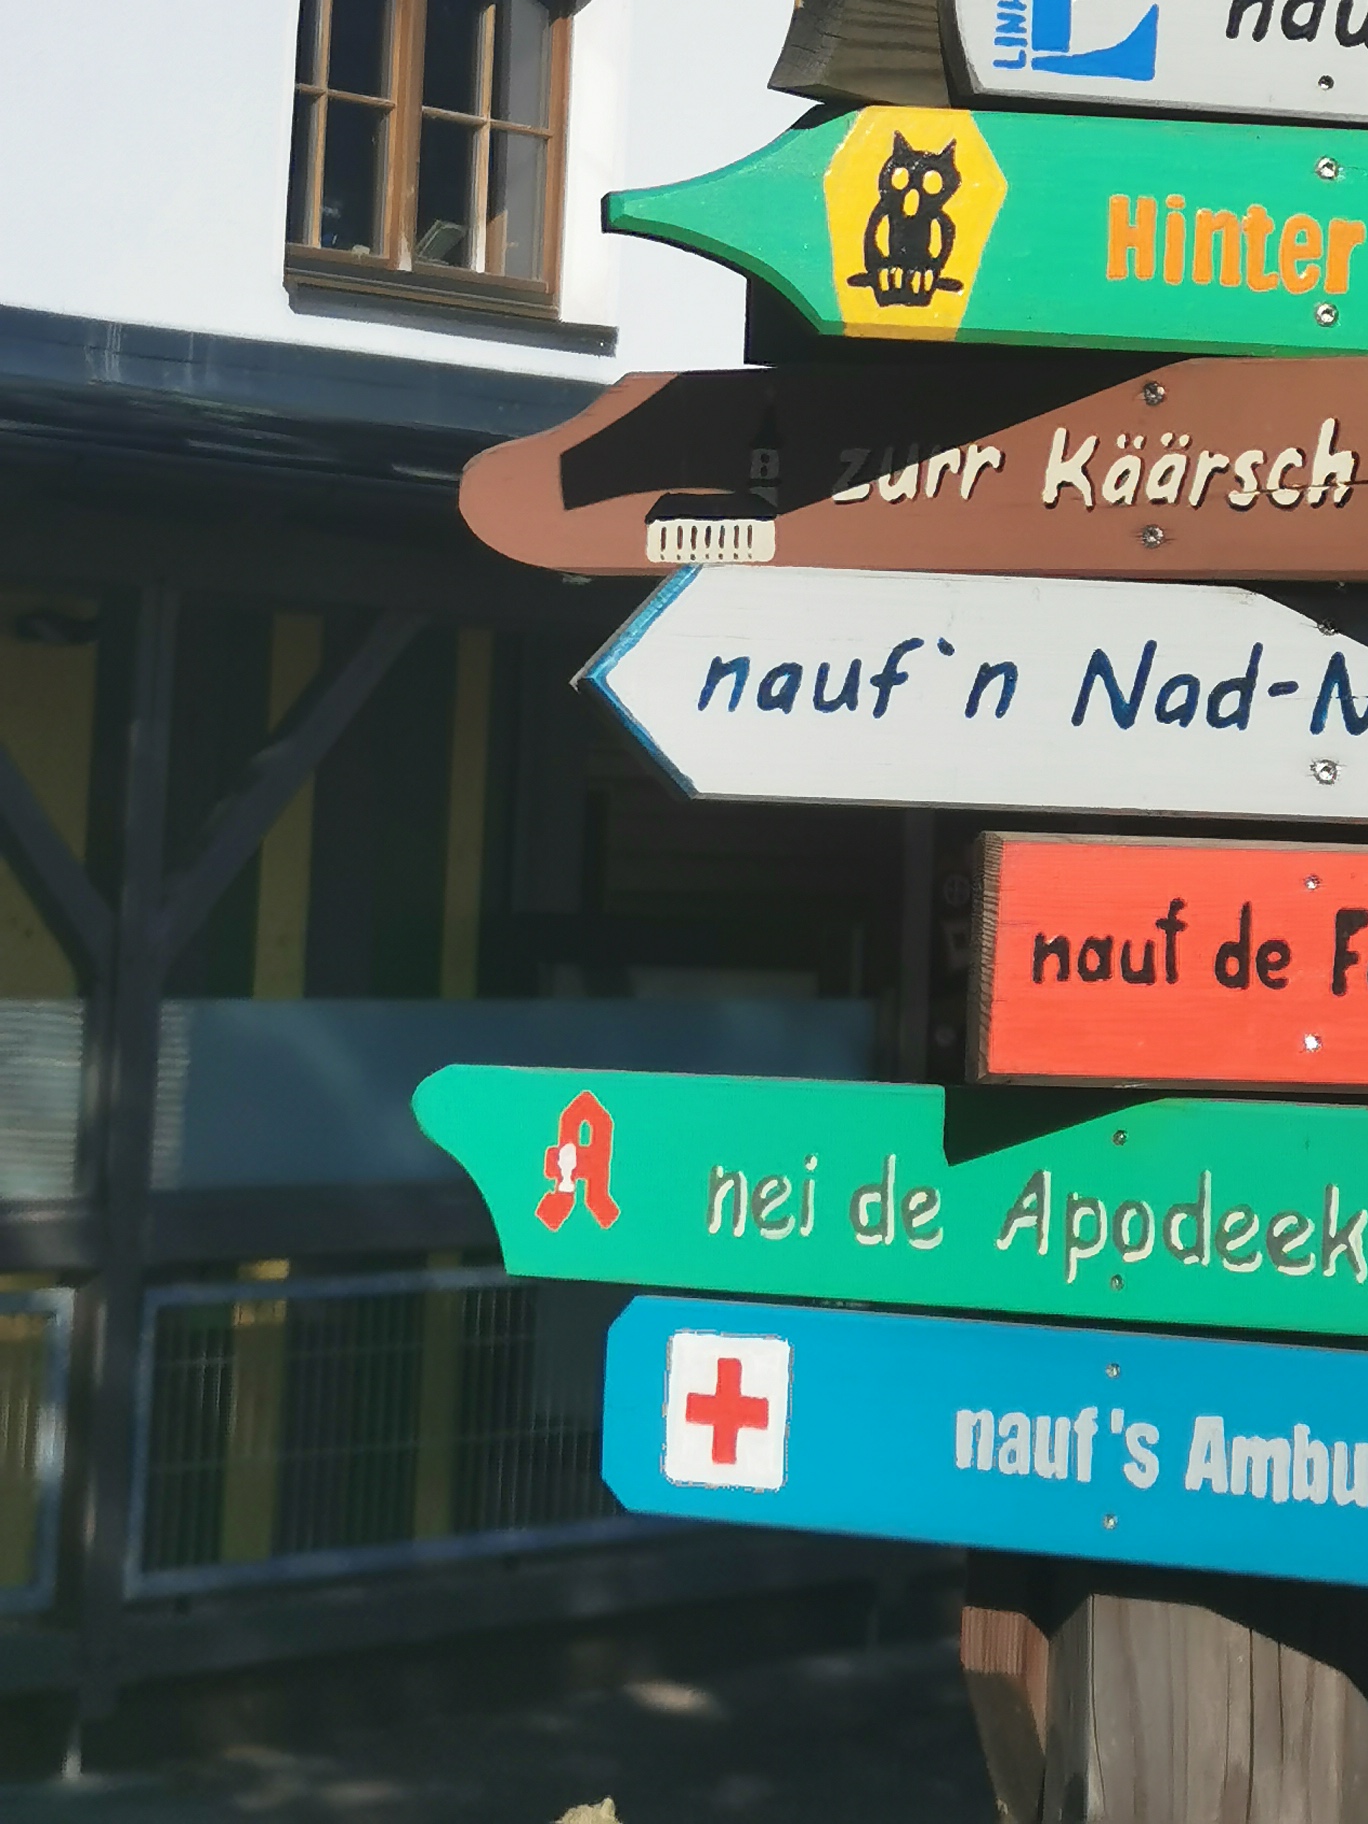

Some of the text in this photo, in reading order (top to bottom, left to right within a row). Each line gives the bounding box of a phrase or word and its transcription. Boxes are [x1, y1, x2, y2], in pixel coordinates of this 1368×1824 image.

[1107, 192, 1365, 296] Hinter
[832, 417, 1356, 512] zurr Käärsch
[1032, 897, 1187, 987] nauf
[1214, 901, 1290, 993] de
[705, 1152, 1368, 1282] nei de Apodeek
